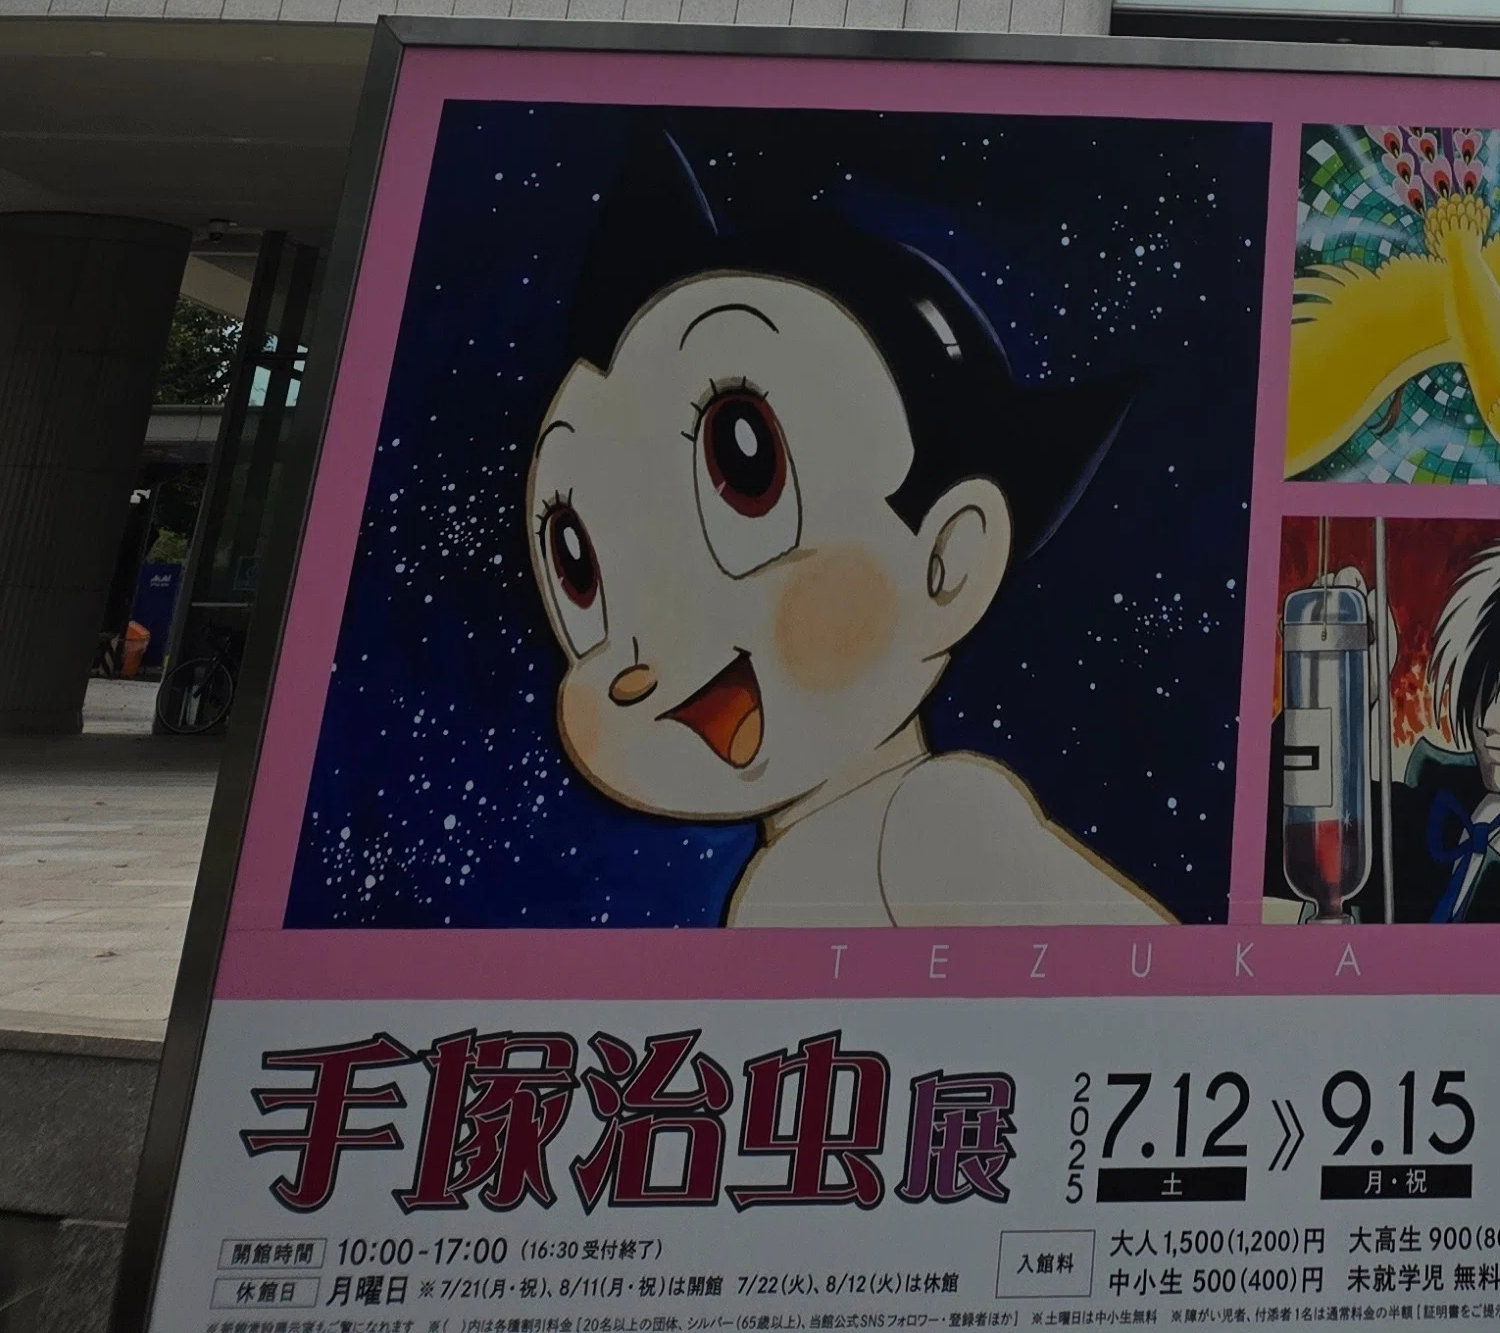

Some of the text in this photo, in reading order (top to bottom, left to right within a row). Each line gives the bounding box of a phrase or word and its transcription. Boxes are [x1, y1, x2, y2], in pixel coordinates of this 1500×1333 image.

[830, 944, 1362, 979] TEZUKA
[239, 1027, 1018, 1215] 手塚治虫展
[1101, 1070, 1250, 1160] 7.12
[1321, 1069, 1475, 1157] 9.15
[1160, 1172, 1184, 1196] 土
[1363, 1168, 1428, 1195] 月・祝
[231, 1242, 315, 1265] 開館時間
[1017, 1252, 1074, 1275] 入館料
[235, 1280, 297, 1304] 休館日
[325, 1274, 410, 1307] 月曜日
